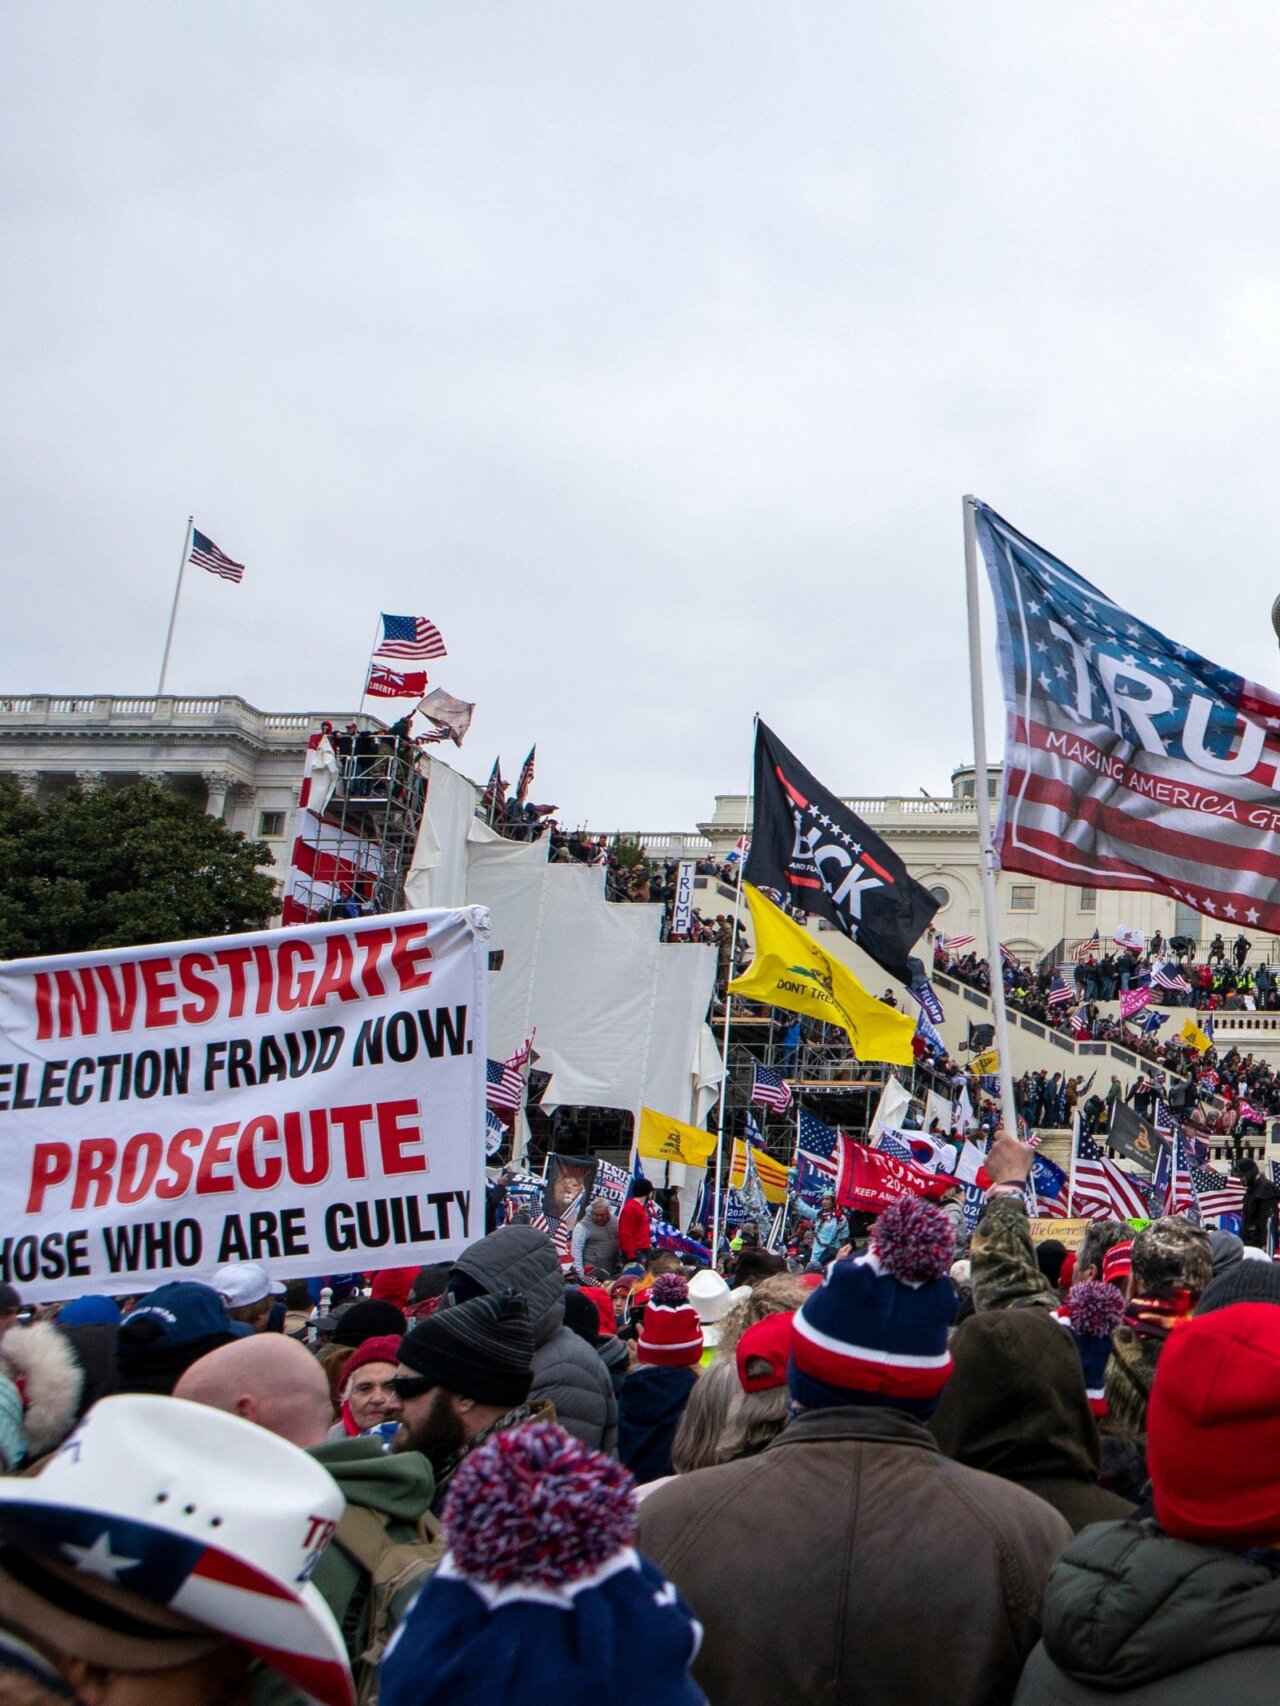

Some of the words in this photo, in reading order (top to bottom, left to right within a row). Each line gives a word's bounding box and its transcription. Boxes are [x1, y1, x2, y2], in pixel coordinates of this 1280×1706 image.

[369, 682, 396, 696] LIBERTY
[1045, 731, 1124, 783] MAKING
[1129, 771, 1239, 820] AMERICA
[676, 864, 692, 932] TRUMP
[34, 922, 432, 1041] INVESTIGATE
[776, 979, 807, 995] DONT
[919, 982, 943, 1023] TRUMP
[204, 1025, 345, 1091] FRAUD
[352, 1005, 473, 1067] NOW.
[25, 1099, 429, 1214] PROSECUTE
[597, 1159, 633, 1182] JESUS
[854, 1186, 877, 1197] KEEP
[102, 1218, 202, 1273] WHO
[217, 1208, 310, 1263] ARE
[324, 1190, 471, 1252] GUILTY
